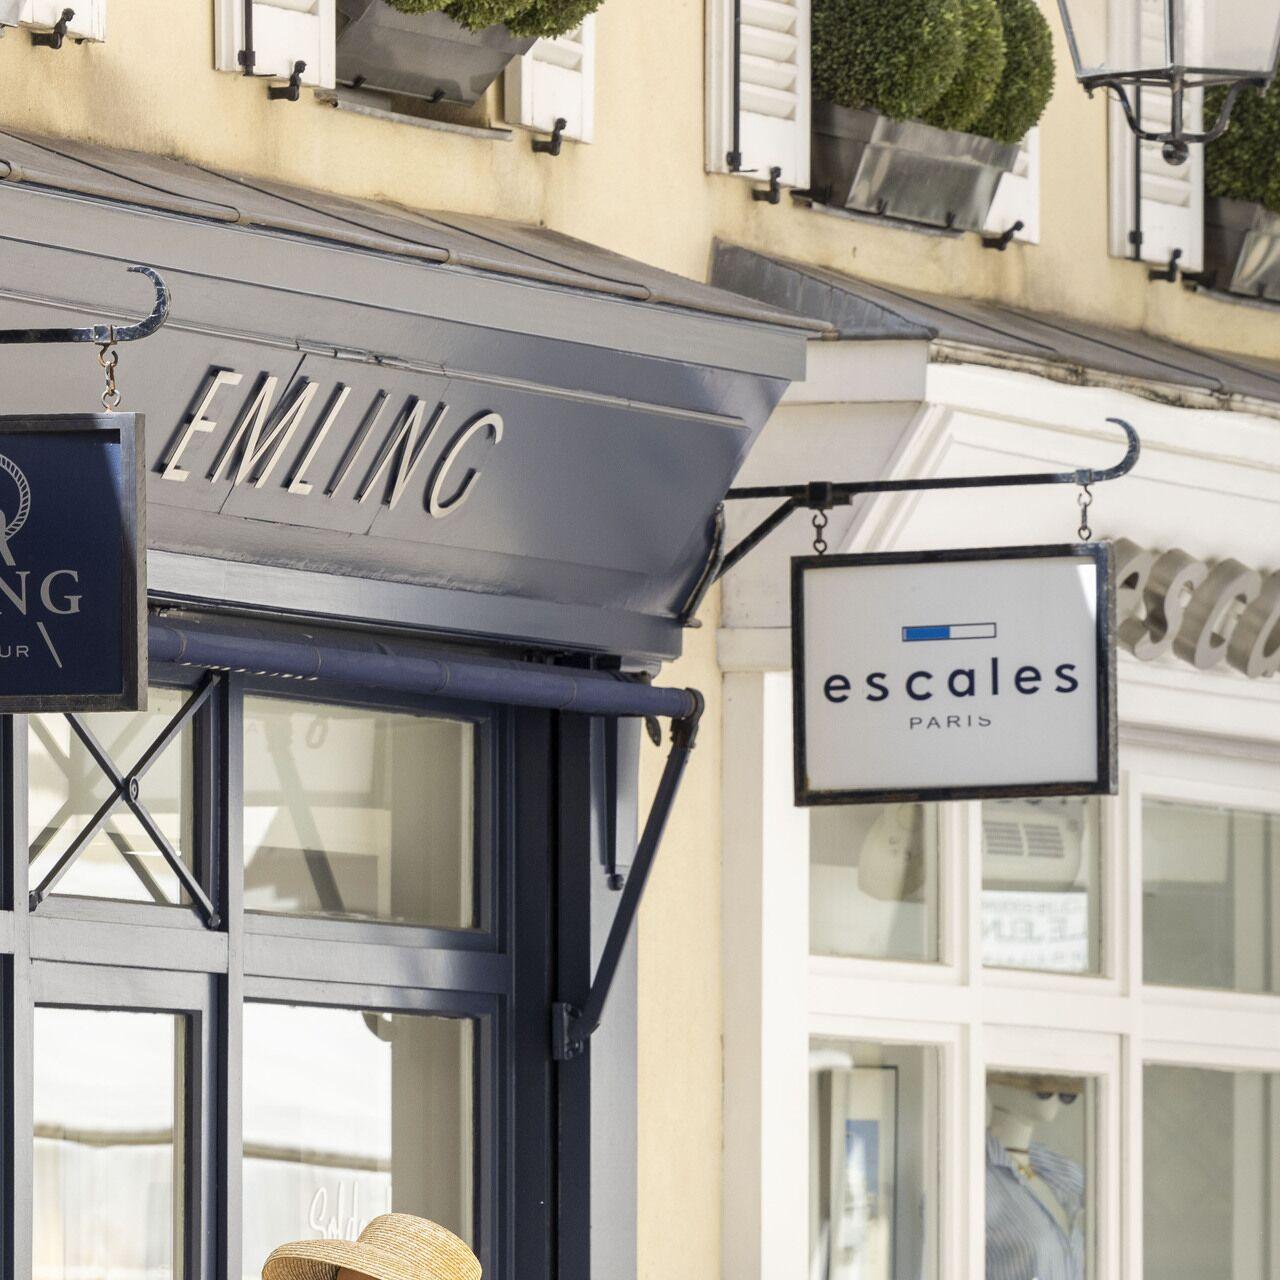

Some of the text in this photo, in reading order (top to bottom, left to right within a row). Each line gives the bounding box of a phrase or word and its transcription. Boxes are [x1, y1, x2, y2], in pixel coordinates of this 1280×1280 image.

[158, 369, 505, 520] EMLING
[823, 656, 1079, 703] escales
[909, 714, 992, 730] PARIS
